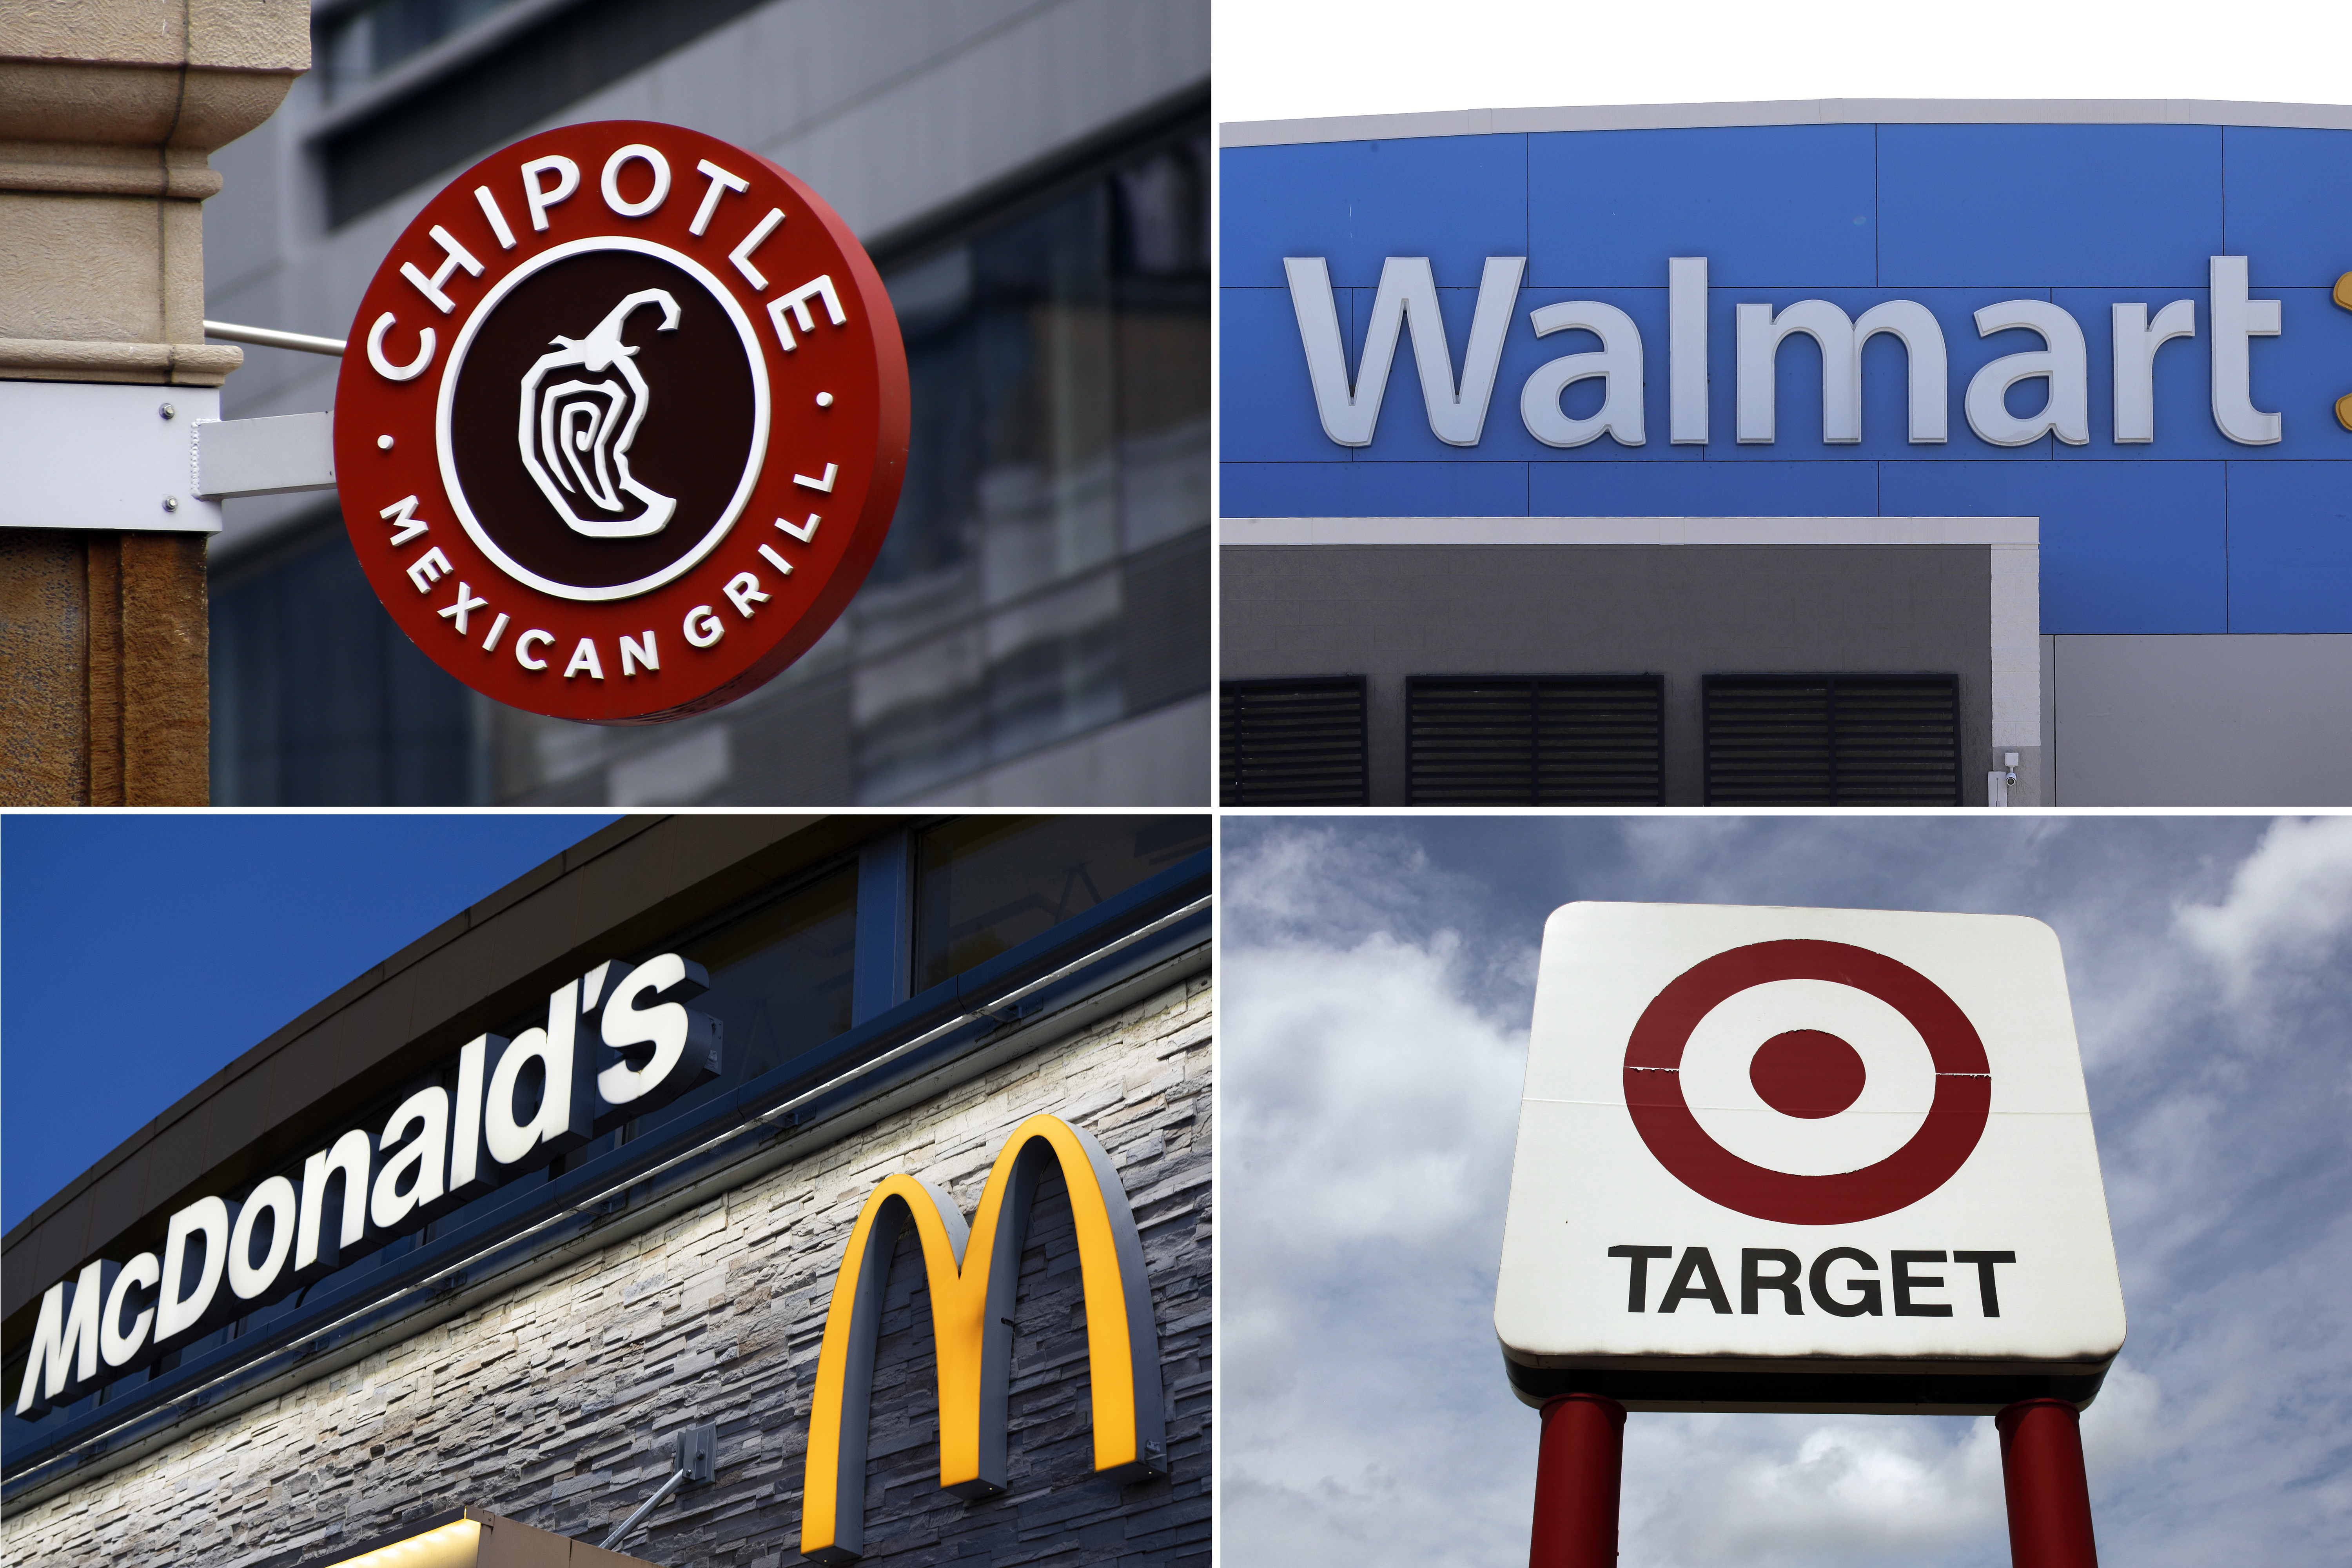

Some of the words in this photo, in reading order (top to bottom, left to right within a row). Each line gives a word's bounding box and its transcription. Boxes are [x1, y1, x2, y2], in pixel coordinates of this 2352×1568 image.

[367, 144, 846, 381] CHIPOTLE
[1282, 256, 2282, 448] Walmart
[380, 495, 660, 679] MEXICAN
[683, 463, 838, 647] GRILL
[15, 953, 692, 1420] McDonald's
[1608, 1245, 2016, 1318] TARGET
